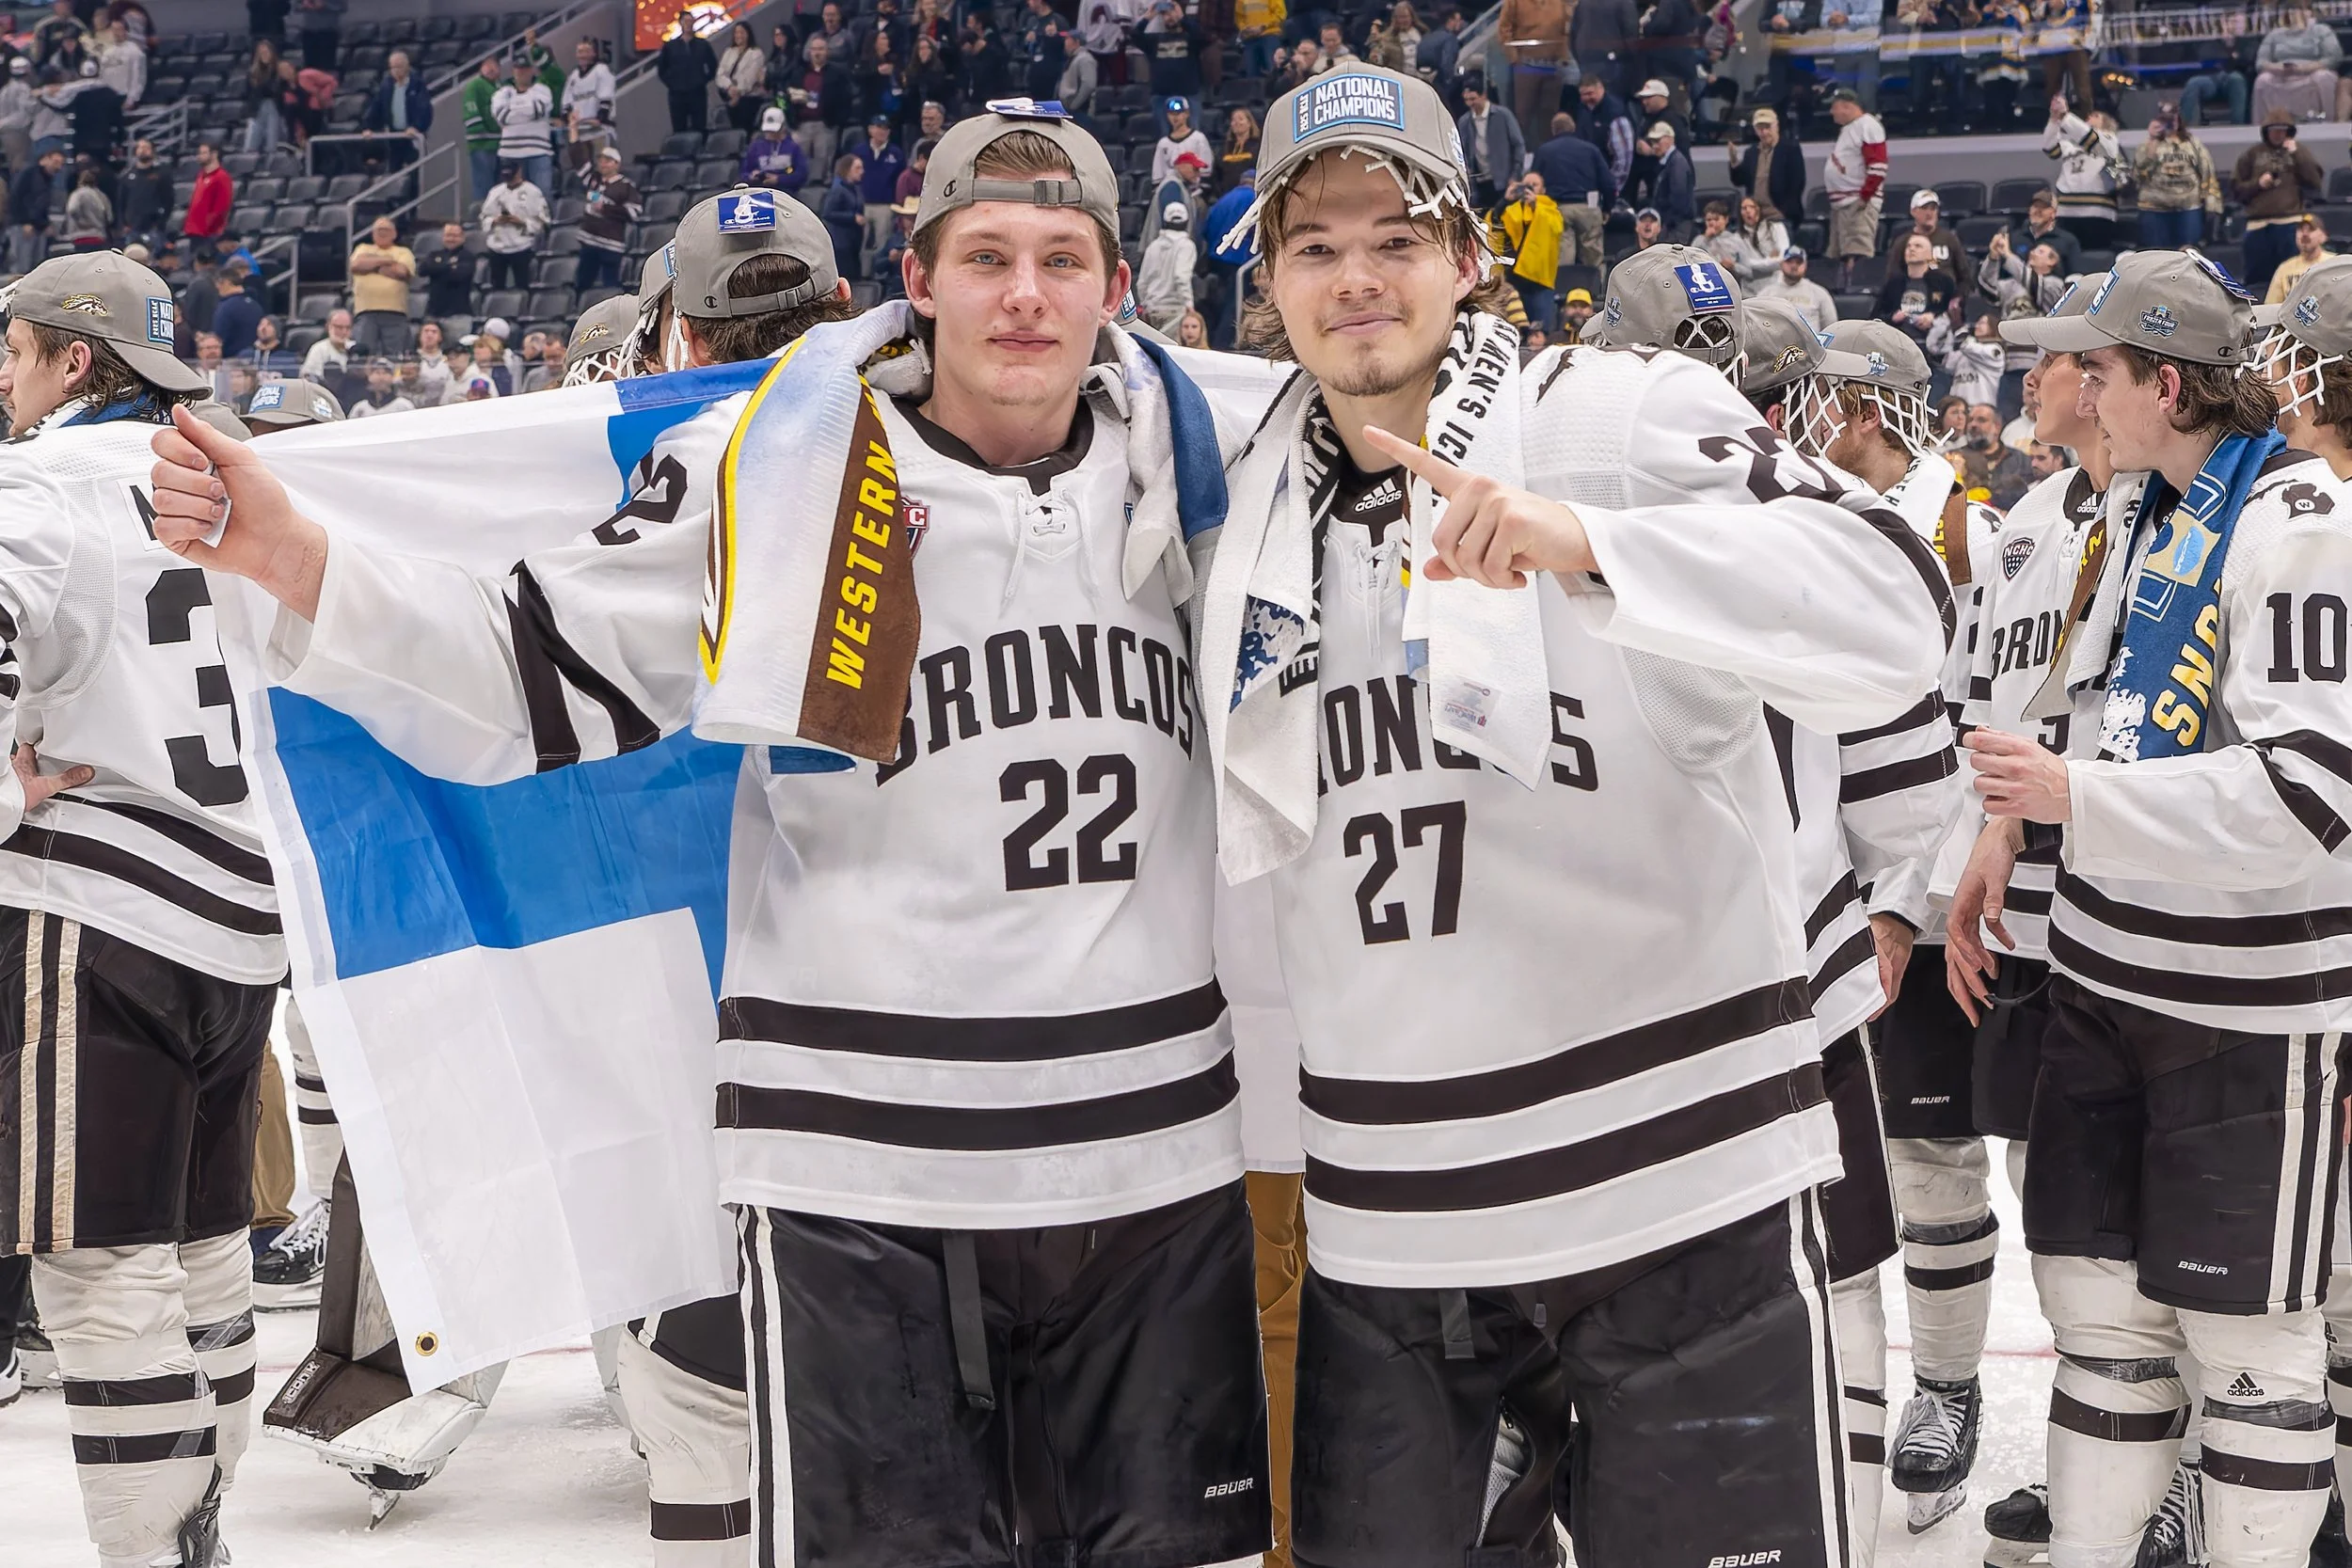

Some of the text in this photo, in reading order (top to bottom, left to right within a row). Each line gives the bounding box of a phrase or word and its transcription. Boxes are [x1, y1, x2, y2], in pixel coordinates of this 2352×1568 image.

[1315, 77, 1394, 105] NATIONAL
[1313, 96, 1396, 125] CHAMPIONS
[1456, 337, 1511, 420] MEN'S
[1354, 489, 1403, 513] adidas
[2076, 505, 2099, 514] adidas
[2004, 543, 2035, 558] NCHC
[825, 439, 897, 690] WESTERN
[2265, 592, 2348, 684] 10
[998, 753, 1138, 892] 22
[1343, 800, 1468, 945] 27
[1911, 1096, 1951, 1105] BAUER
[2177, 1260, 2229, 1275] BAUER
[2227, 1387, 2265, 1397] adidas
[1204, 1477, 1254, 1498] BAUER
[1707, 1549, 1782, 1568] BAUER
